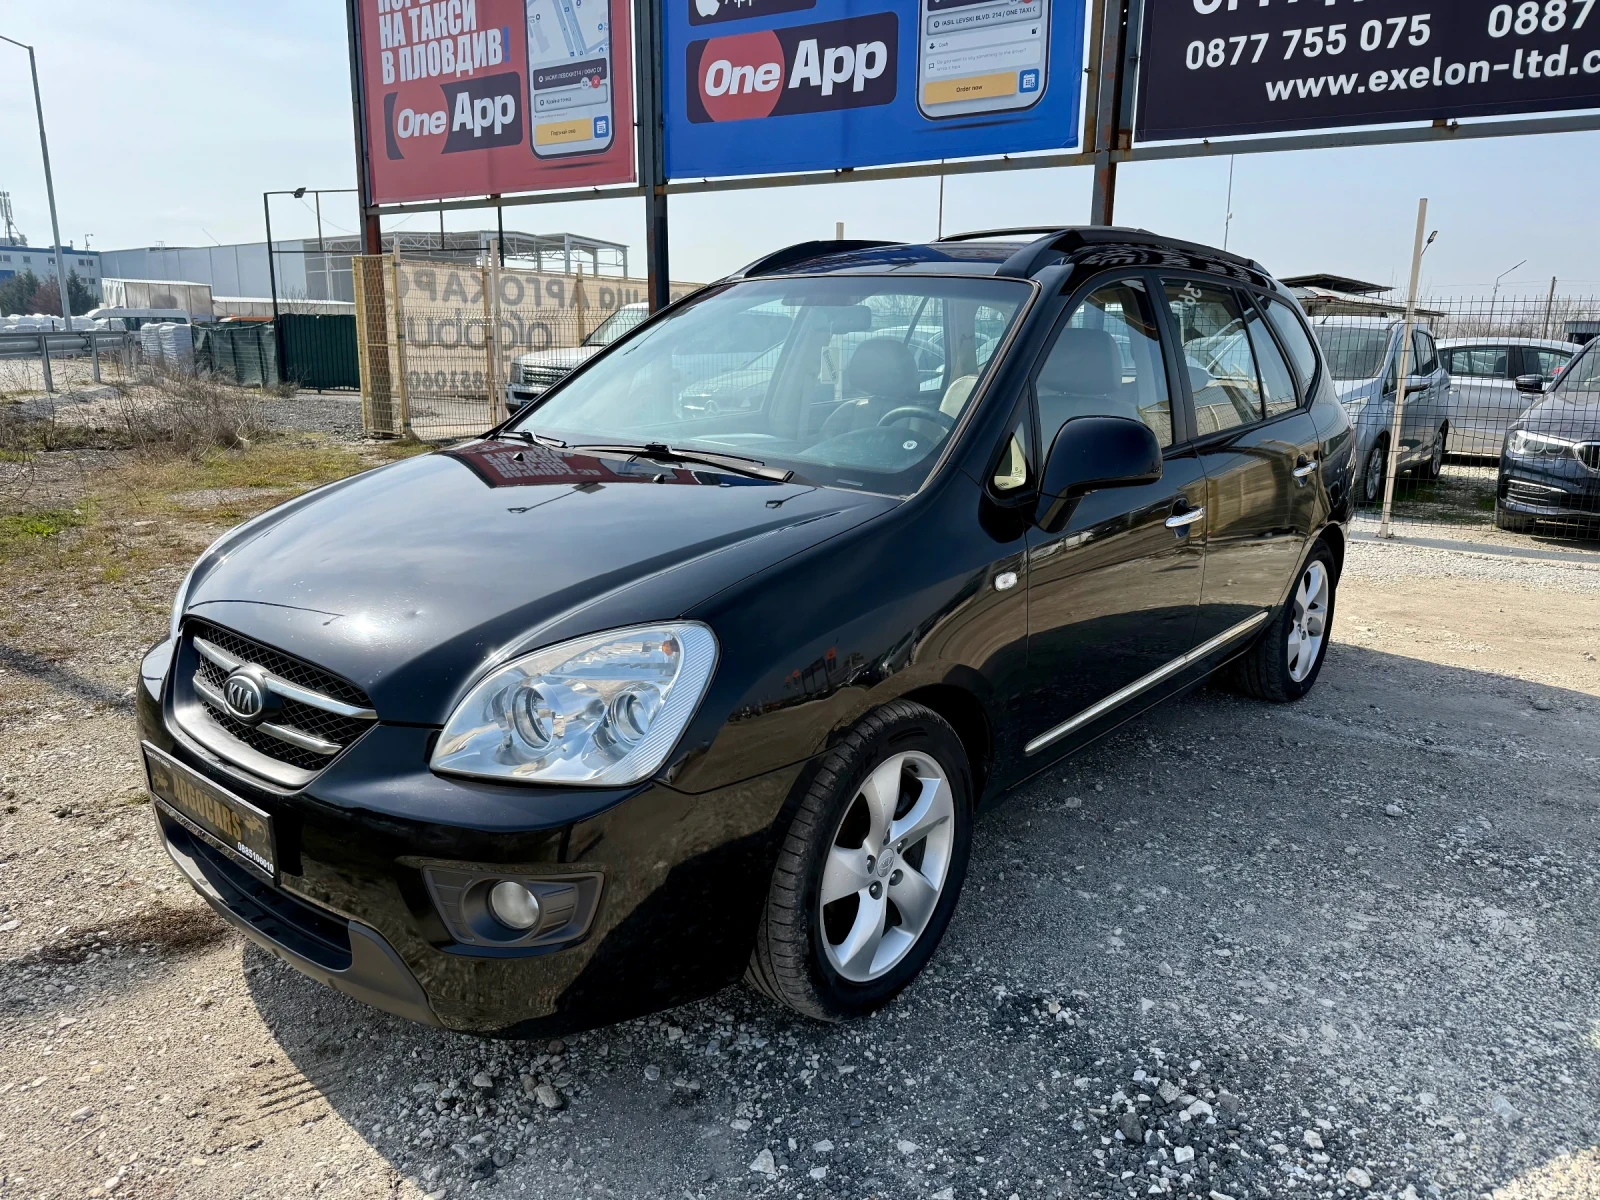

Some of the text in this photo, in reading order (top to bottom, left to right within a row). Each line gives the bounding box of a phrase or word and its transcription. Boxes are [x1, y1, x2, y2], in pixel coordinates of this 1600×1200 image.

[379, 0, 477, 49] НА ТАКСИ
[956, 17, 975, 25] LEVSKI
[1186, 14, 1431, 70] 0877 755 075
[1488, 0, 1595, 38] 0887
[381, 26, 510, 84] В ПЛОВДИВ!
[704, 38, 888, 97] One App
[1265, 44, 1600, 101] www.exelon-ltd.c
[397, 91, 515, 139] One App
[228, 682, 252, 713] KIA
[173, 771, 242, 841] ARGOCARS
